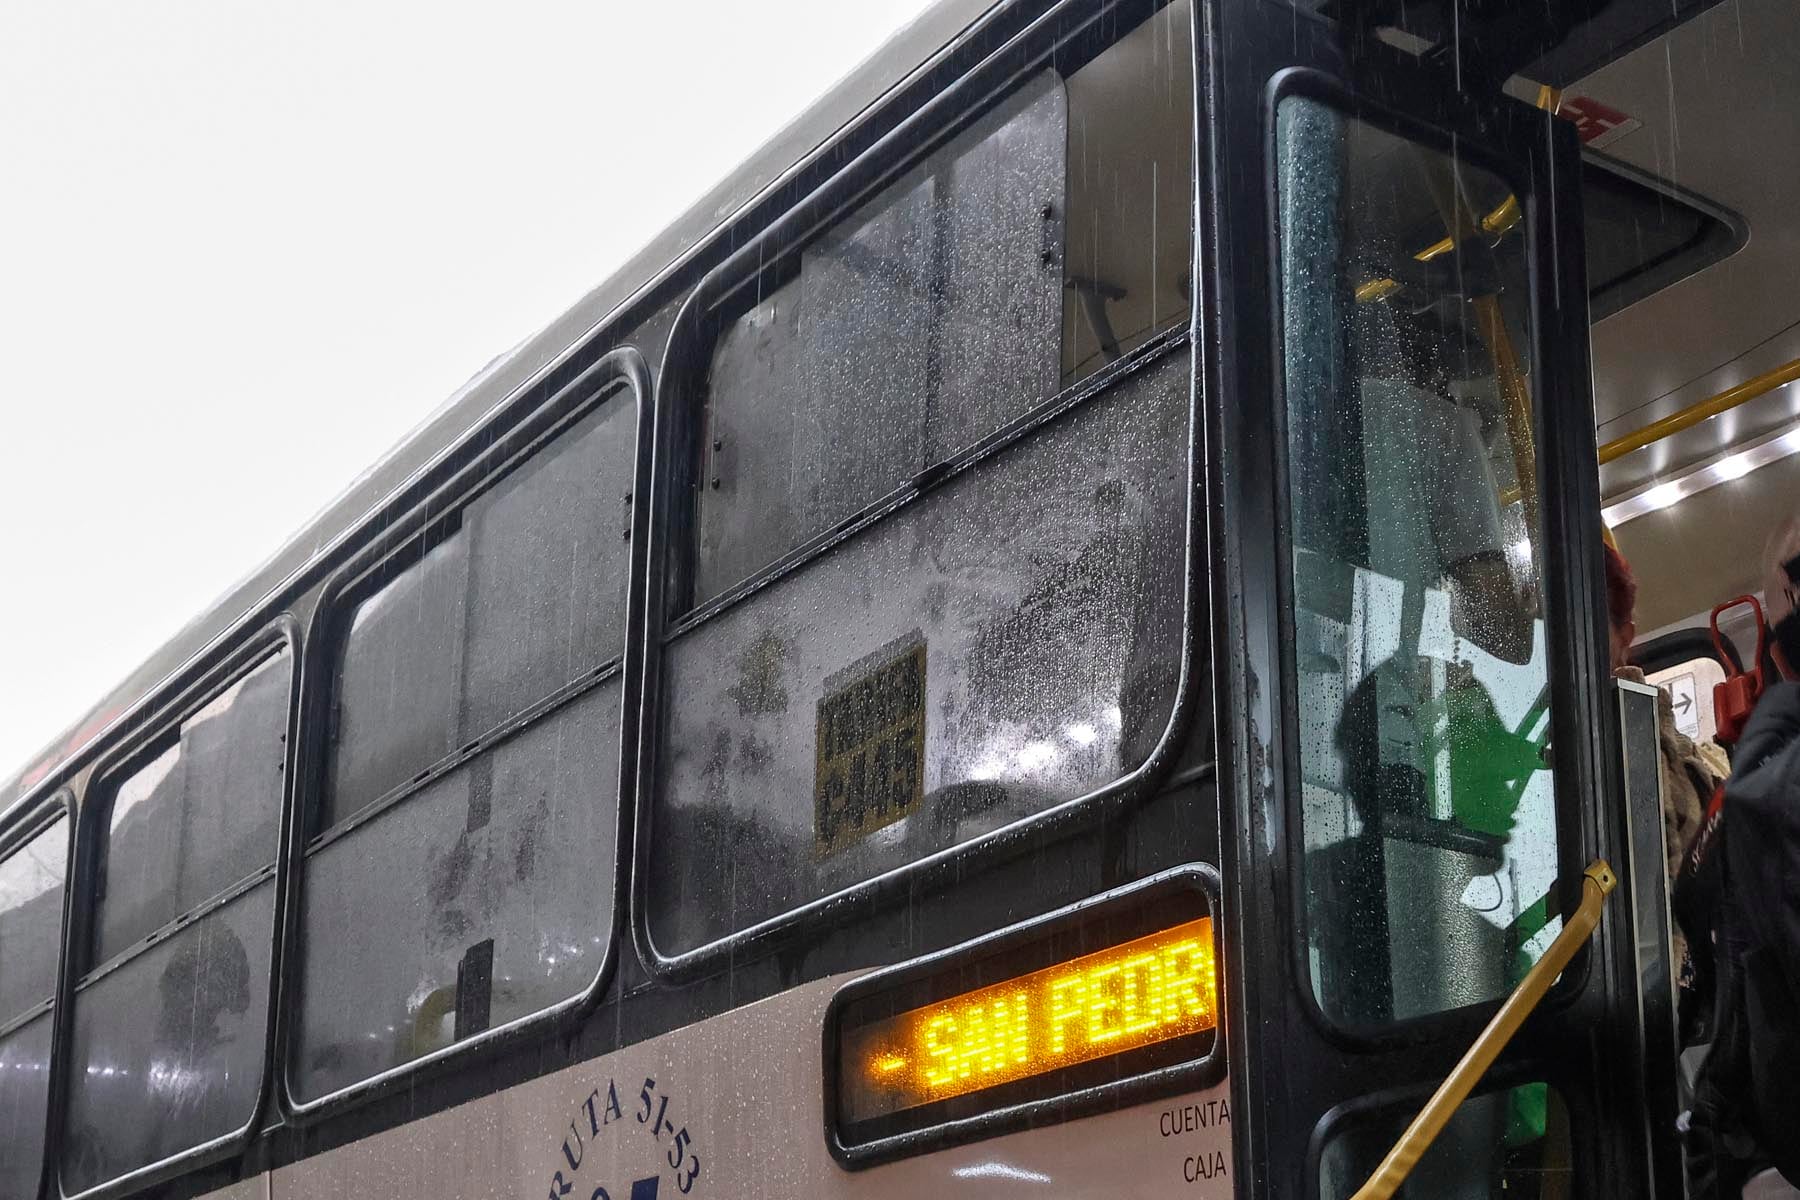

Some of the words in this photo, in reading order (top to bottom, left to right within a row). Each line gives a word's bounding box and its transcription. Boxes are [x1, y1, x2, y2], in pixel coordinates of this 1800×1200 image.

[924, 992, 1028, 1088] SAN
[636, 1076, 701, 1195] 51-53
[1159, 1099, 1231, 1138] CUENTA
[1184, 1151, 1227, 1184] CAJA
